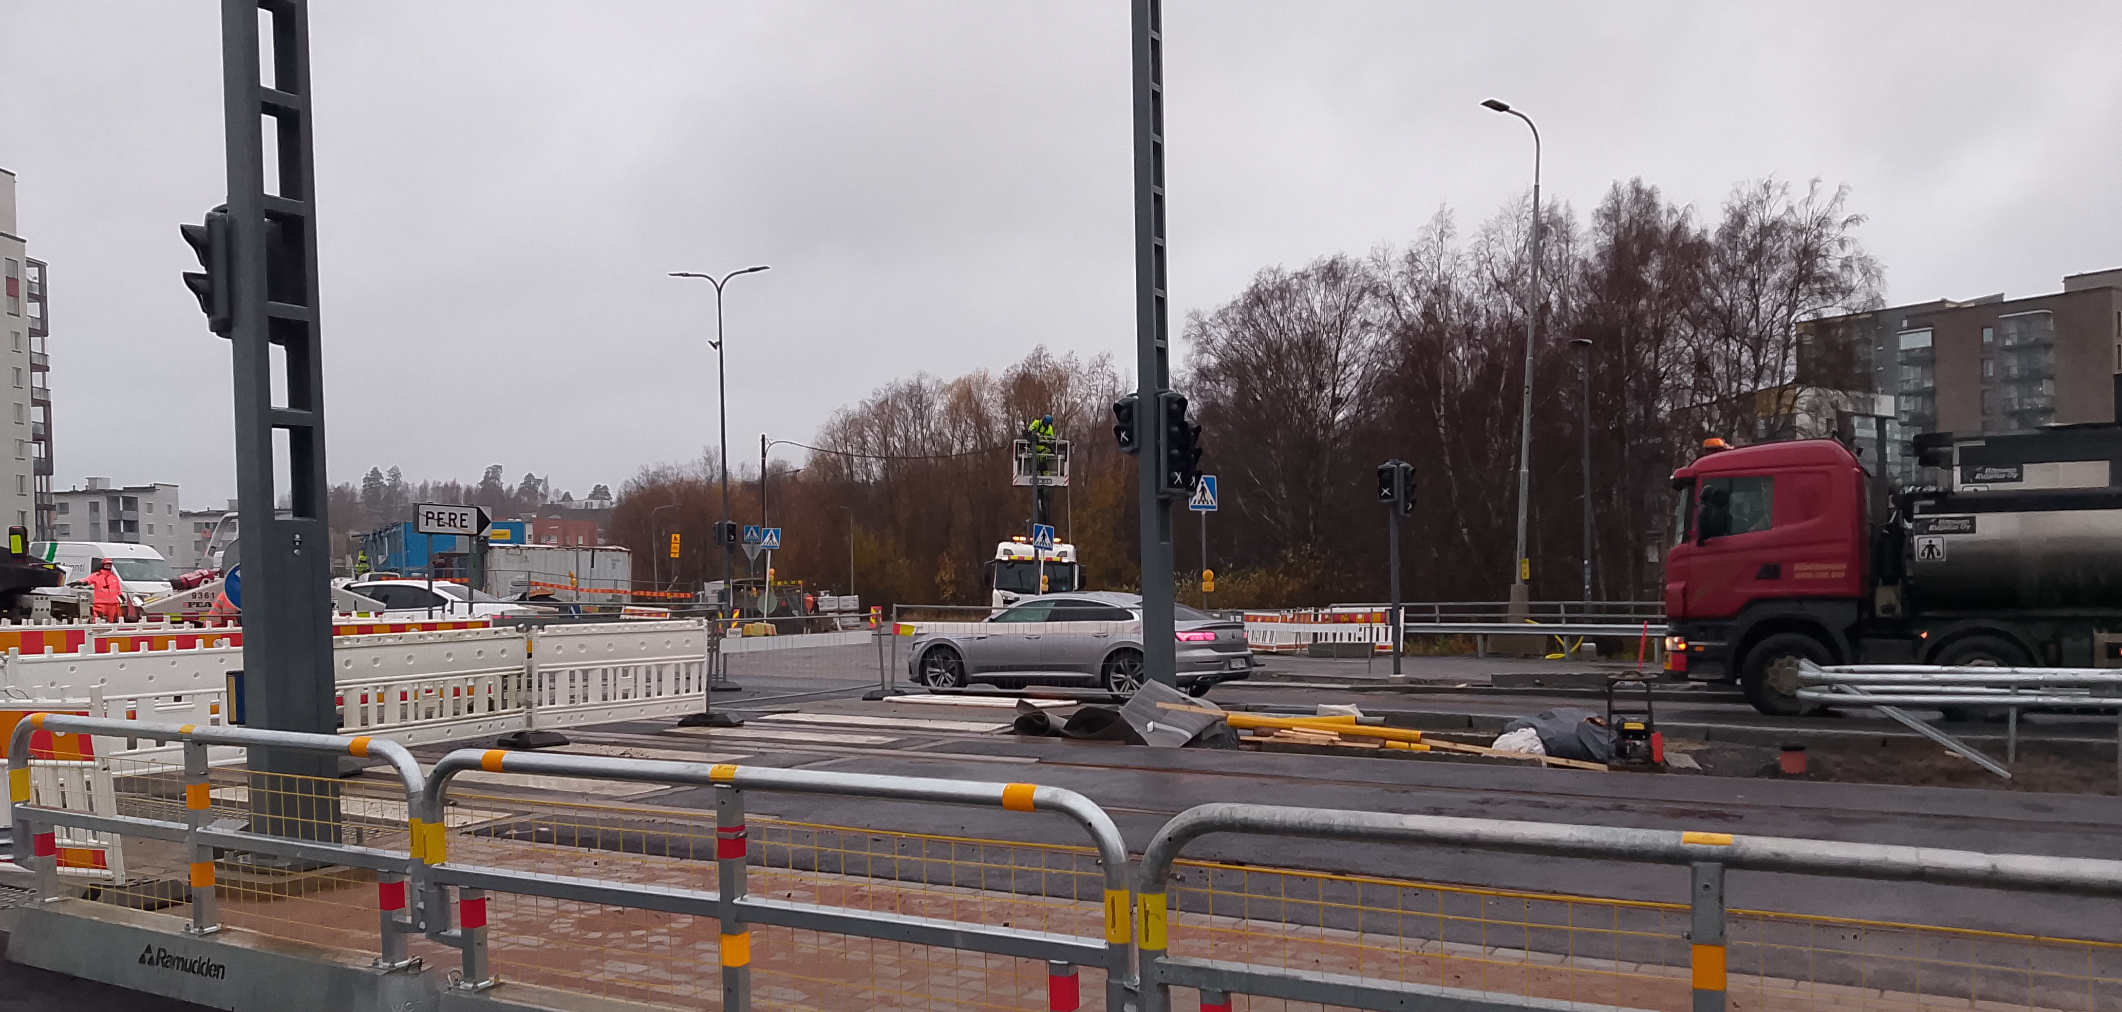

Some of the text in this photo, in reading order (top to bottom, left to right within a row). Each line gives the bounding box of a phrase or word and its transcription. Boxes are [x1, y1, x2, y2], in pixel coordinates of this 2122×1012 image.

[425, 510, 469, 529] PERE
[191, 591, 215, 600] 9361
[155, 947, 226, 980] Ramudden
